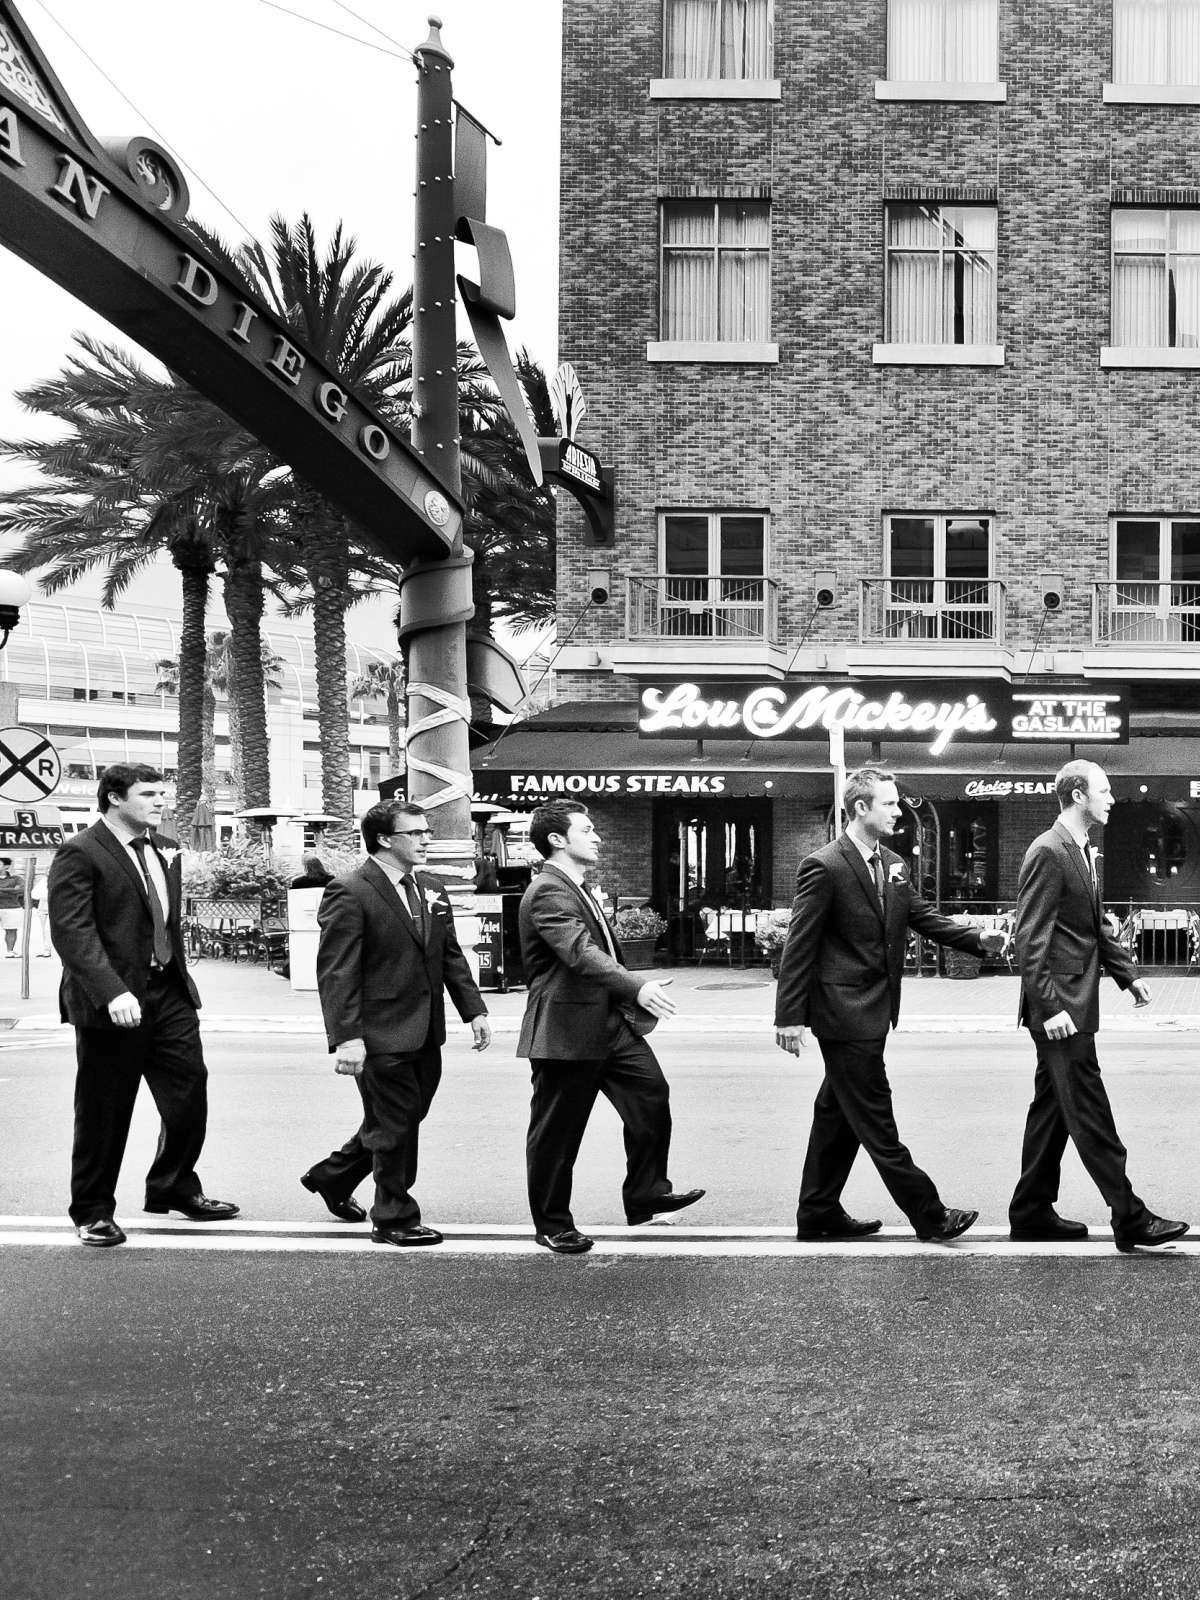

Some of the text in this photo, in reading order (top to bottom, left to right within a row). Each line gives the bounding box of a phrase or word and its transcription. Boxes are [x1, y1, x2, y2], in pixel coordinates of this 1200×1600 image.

[177, 253, 391, 461] DIEGO
[1028, 700, 1107, 716] AT THE
[639, 682, 742, 732] Lou
[794, 685, 997, 756] Mickey's
[1011, 715, 1121, 733] GASLAMP
[38, 758, 54, 777] R
[511, 775, 725, 793] FAMOUS STEAKS
[965, 780, 1013, 797] Choice
[21, 813, 34, 828] 3
